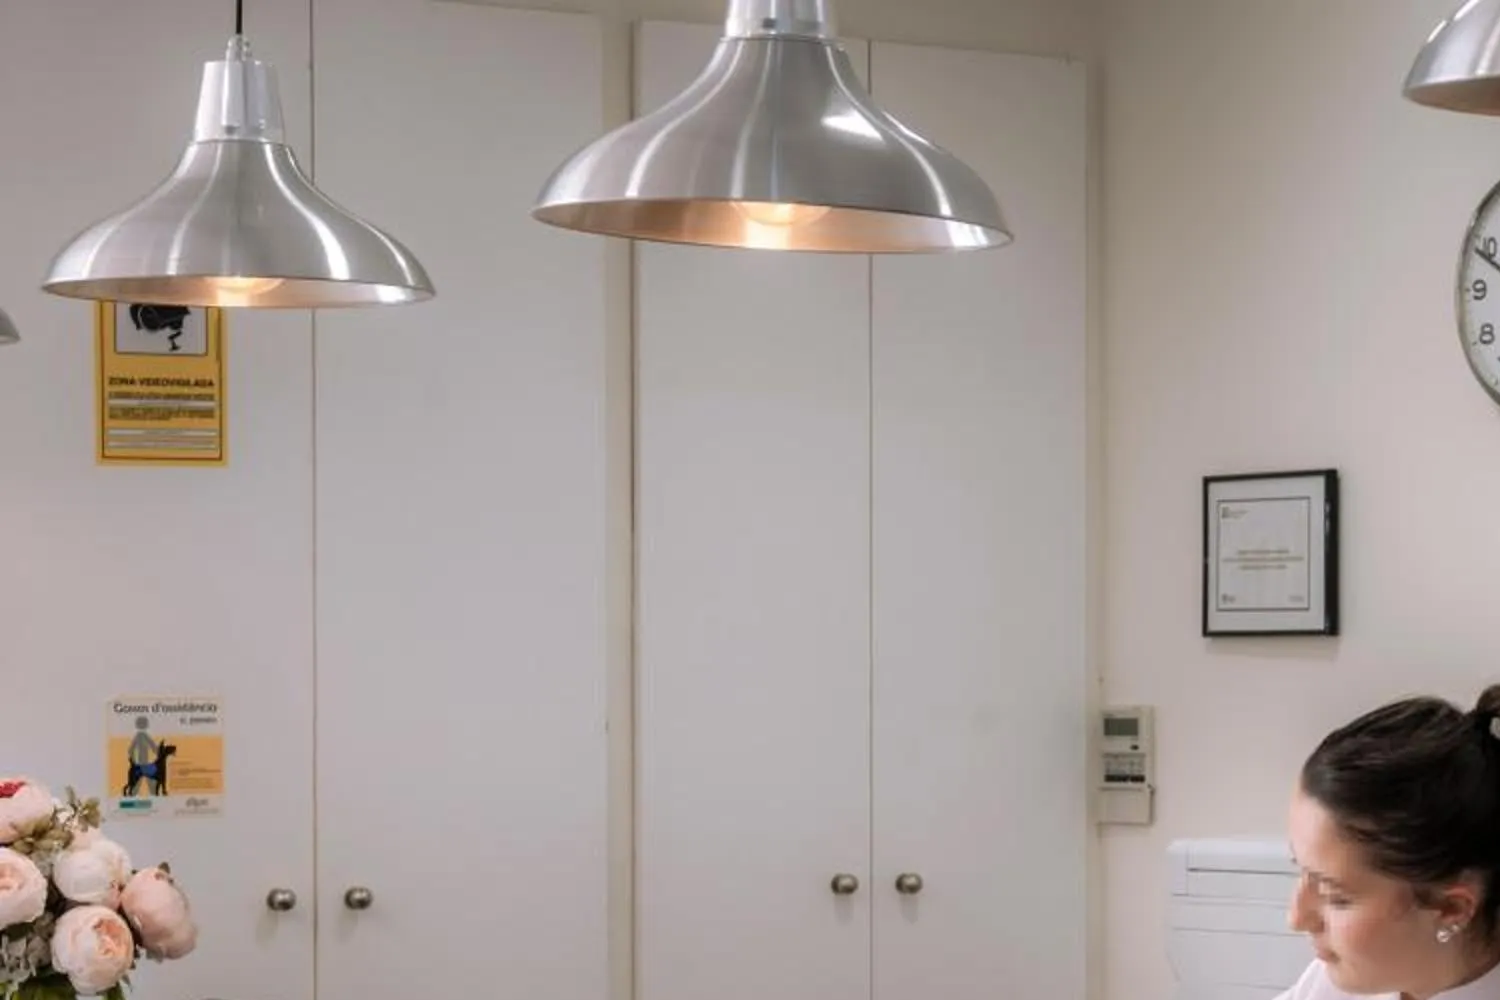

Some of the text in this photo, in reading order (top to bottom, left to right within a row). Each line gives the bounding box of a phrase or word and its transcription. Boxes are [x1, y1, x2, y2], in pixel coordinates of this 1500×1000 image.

[1483, 237, 1498, 258] 10
[1472, 280, 1487, 300] 9
[1480, 324, 1495, 344] 8
[108, 376, 136, 386] ZONA
